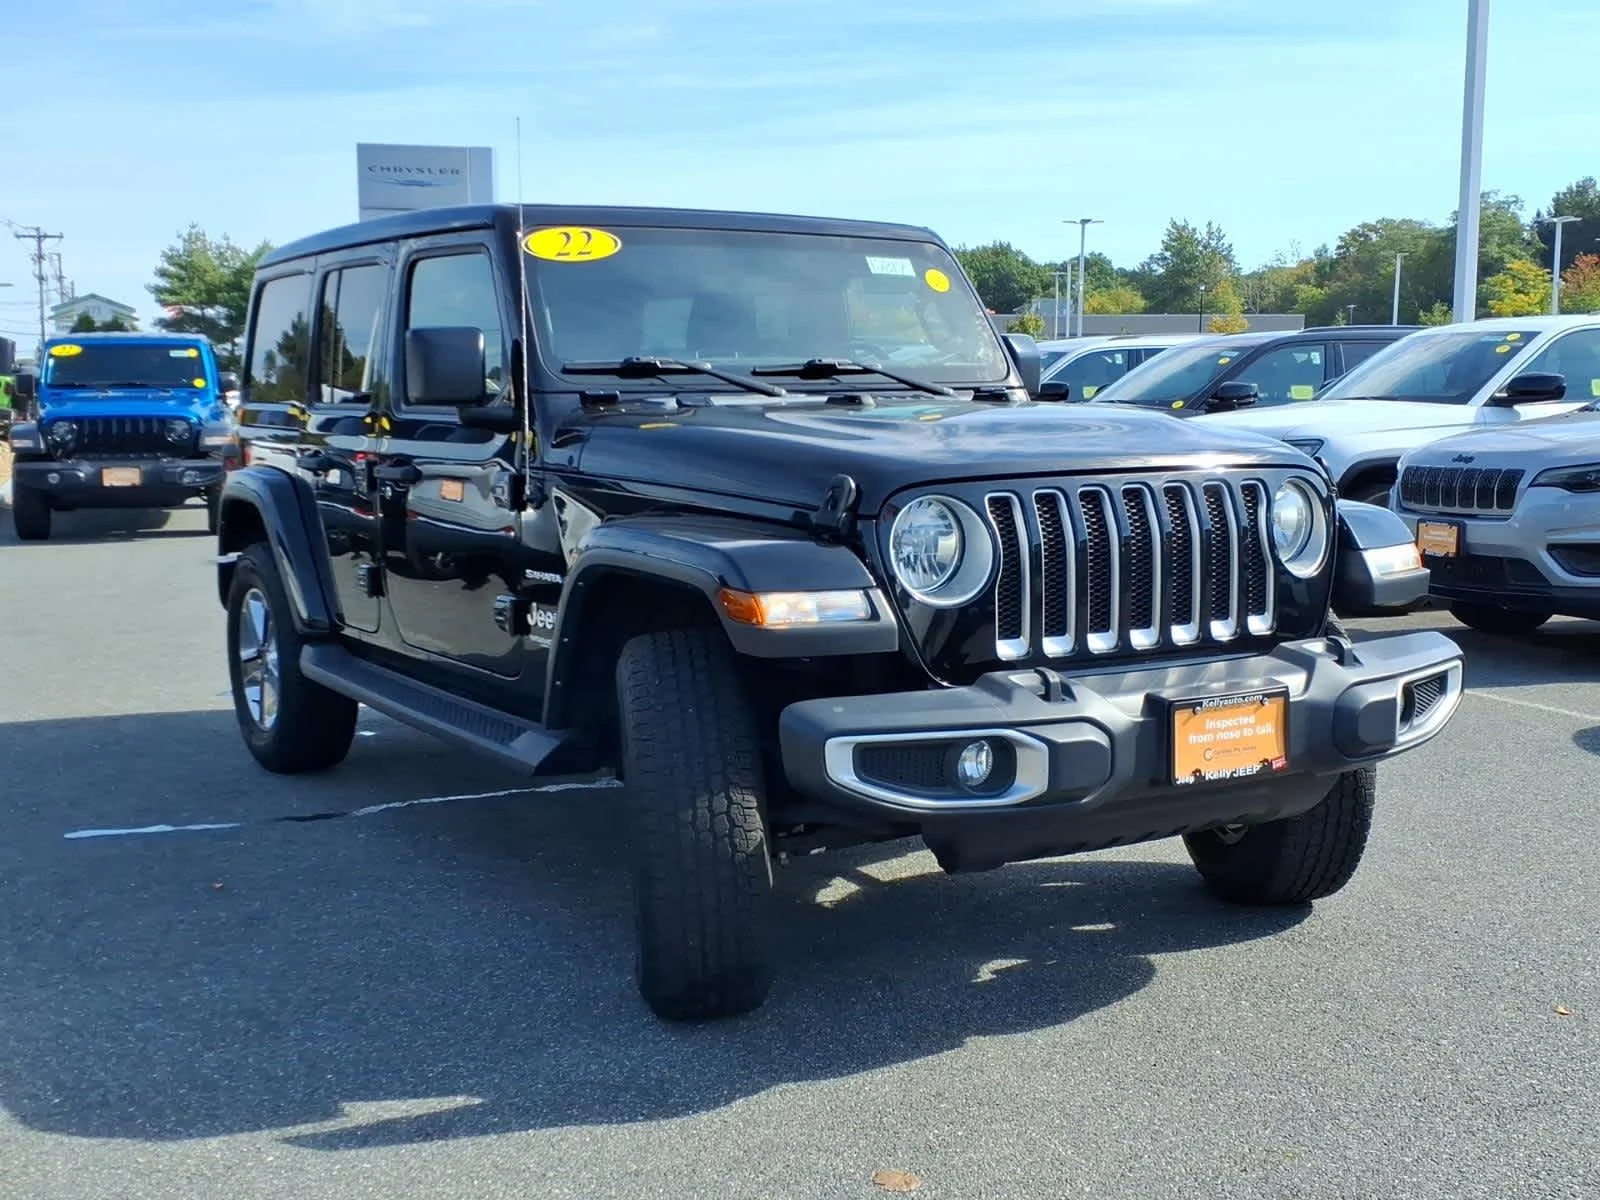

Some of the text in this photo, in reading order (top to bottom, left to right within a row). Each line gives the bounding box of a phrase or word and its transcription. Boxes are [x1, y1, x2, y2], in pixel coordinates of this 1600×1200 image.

[367, 164, 460, 175] CHRYSLER
[555, 231, 593, 257] 22
[1202, 695, 1262, 708] Kellyauto.com
[1206, 716, 1256, 729] Inspected
[1189, 734, 1214, 745] from
[1216, 729, 1241, 741] nose
[1243, 728, 1254, 737] to
